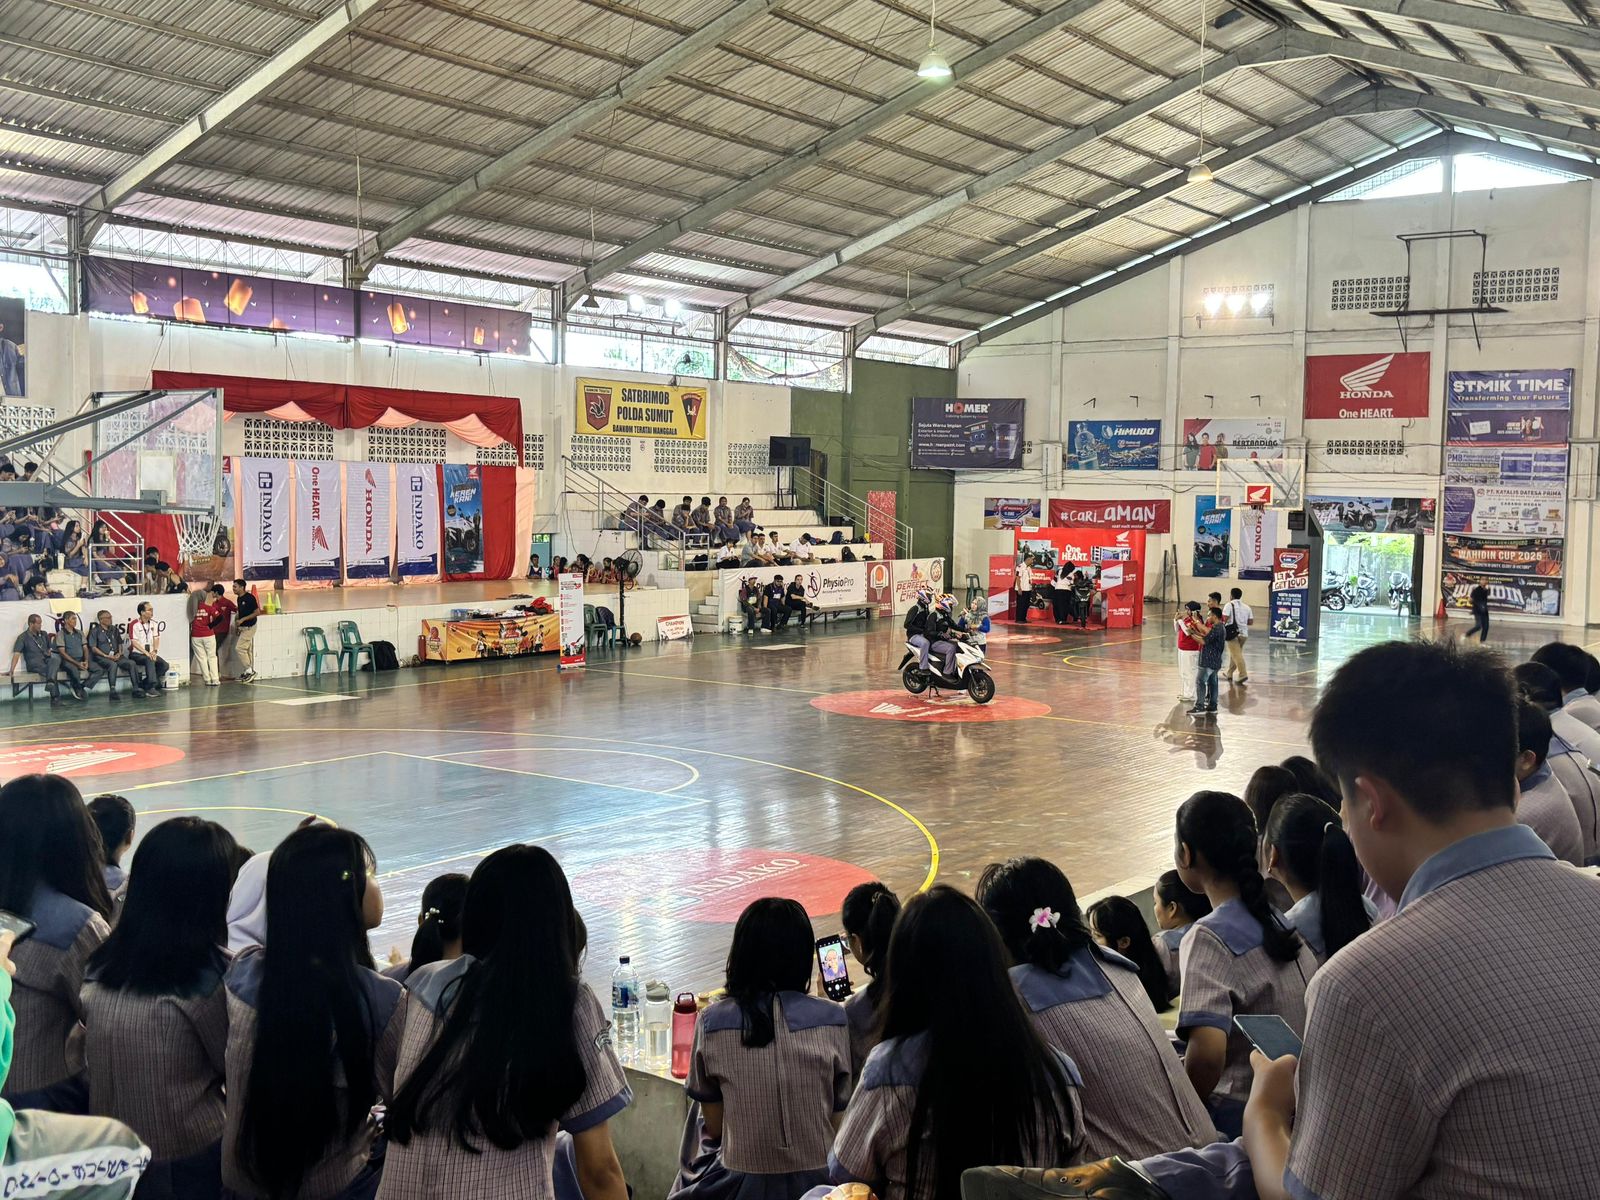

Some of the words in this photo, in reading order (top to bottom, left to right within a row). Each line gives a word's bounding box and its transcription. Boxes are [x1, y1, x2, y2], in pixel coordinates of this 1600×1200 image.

[1453, 379, 1512, 393] STMIK
[1517, 378, 1565, 392] TIME
[621, 387, 670, 405] SATBRIMOB
[1339, 390, 1395, 399] HONDA
[1458, 394, 1510, 402] Transforming
[616, 406, 644, 421] POLDA
[645, 408, 674, 424] SUMUT
[945, 403, 989, 414] HOMER
[1339, 408, 1359, 419] One
[1360, 408, 1395, 419] HEART.
[612, 424, 633, 433] BANKOM
[634, 425, 652, 434] TERATAI
[653, 427, 678, 436] MANGGALA
[311, 466, 320, 486] One
[312, 488, 320, 521] HEART.
[262, 492, 273, 553] INDAKO
[365, 488, 373, 555] HONDA
[414, 494, 425, 550] INDAKO
[1065, 544, 1081, 553] One
[1458, 549, 1496, 560] WAHIDIN
[1498, 550, 1516, 560] CUP
[1518, 551, 1543, 561] 2025
[1061, 551, 1088, 562] HEART.
[1274, 570, 1295, 582] LET'S
[822, 576, 855, 590] PhysioPro
[1275, 581, 1287, 590] GET
[1287, 578, 1307, 589] LOUD
[686, 857, 802, 897] INDAKO
